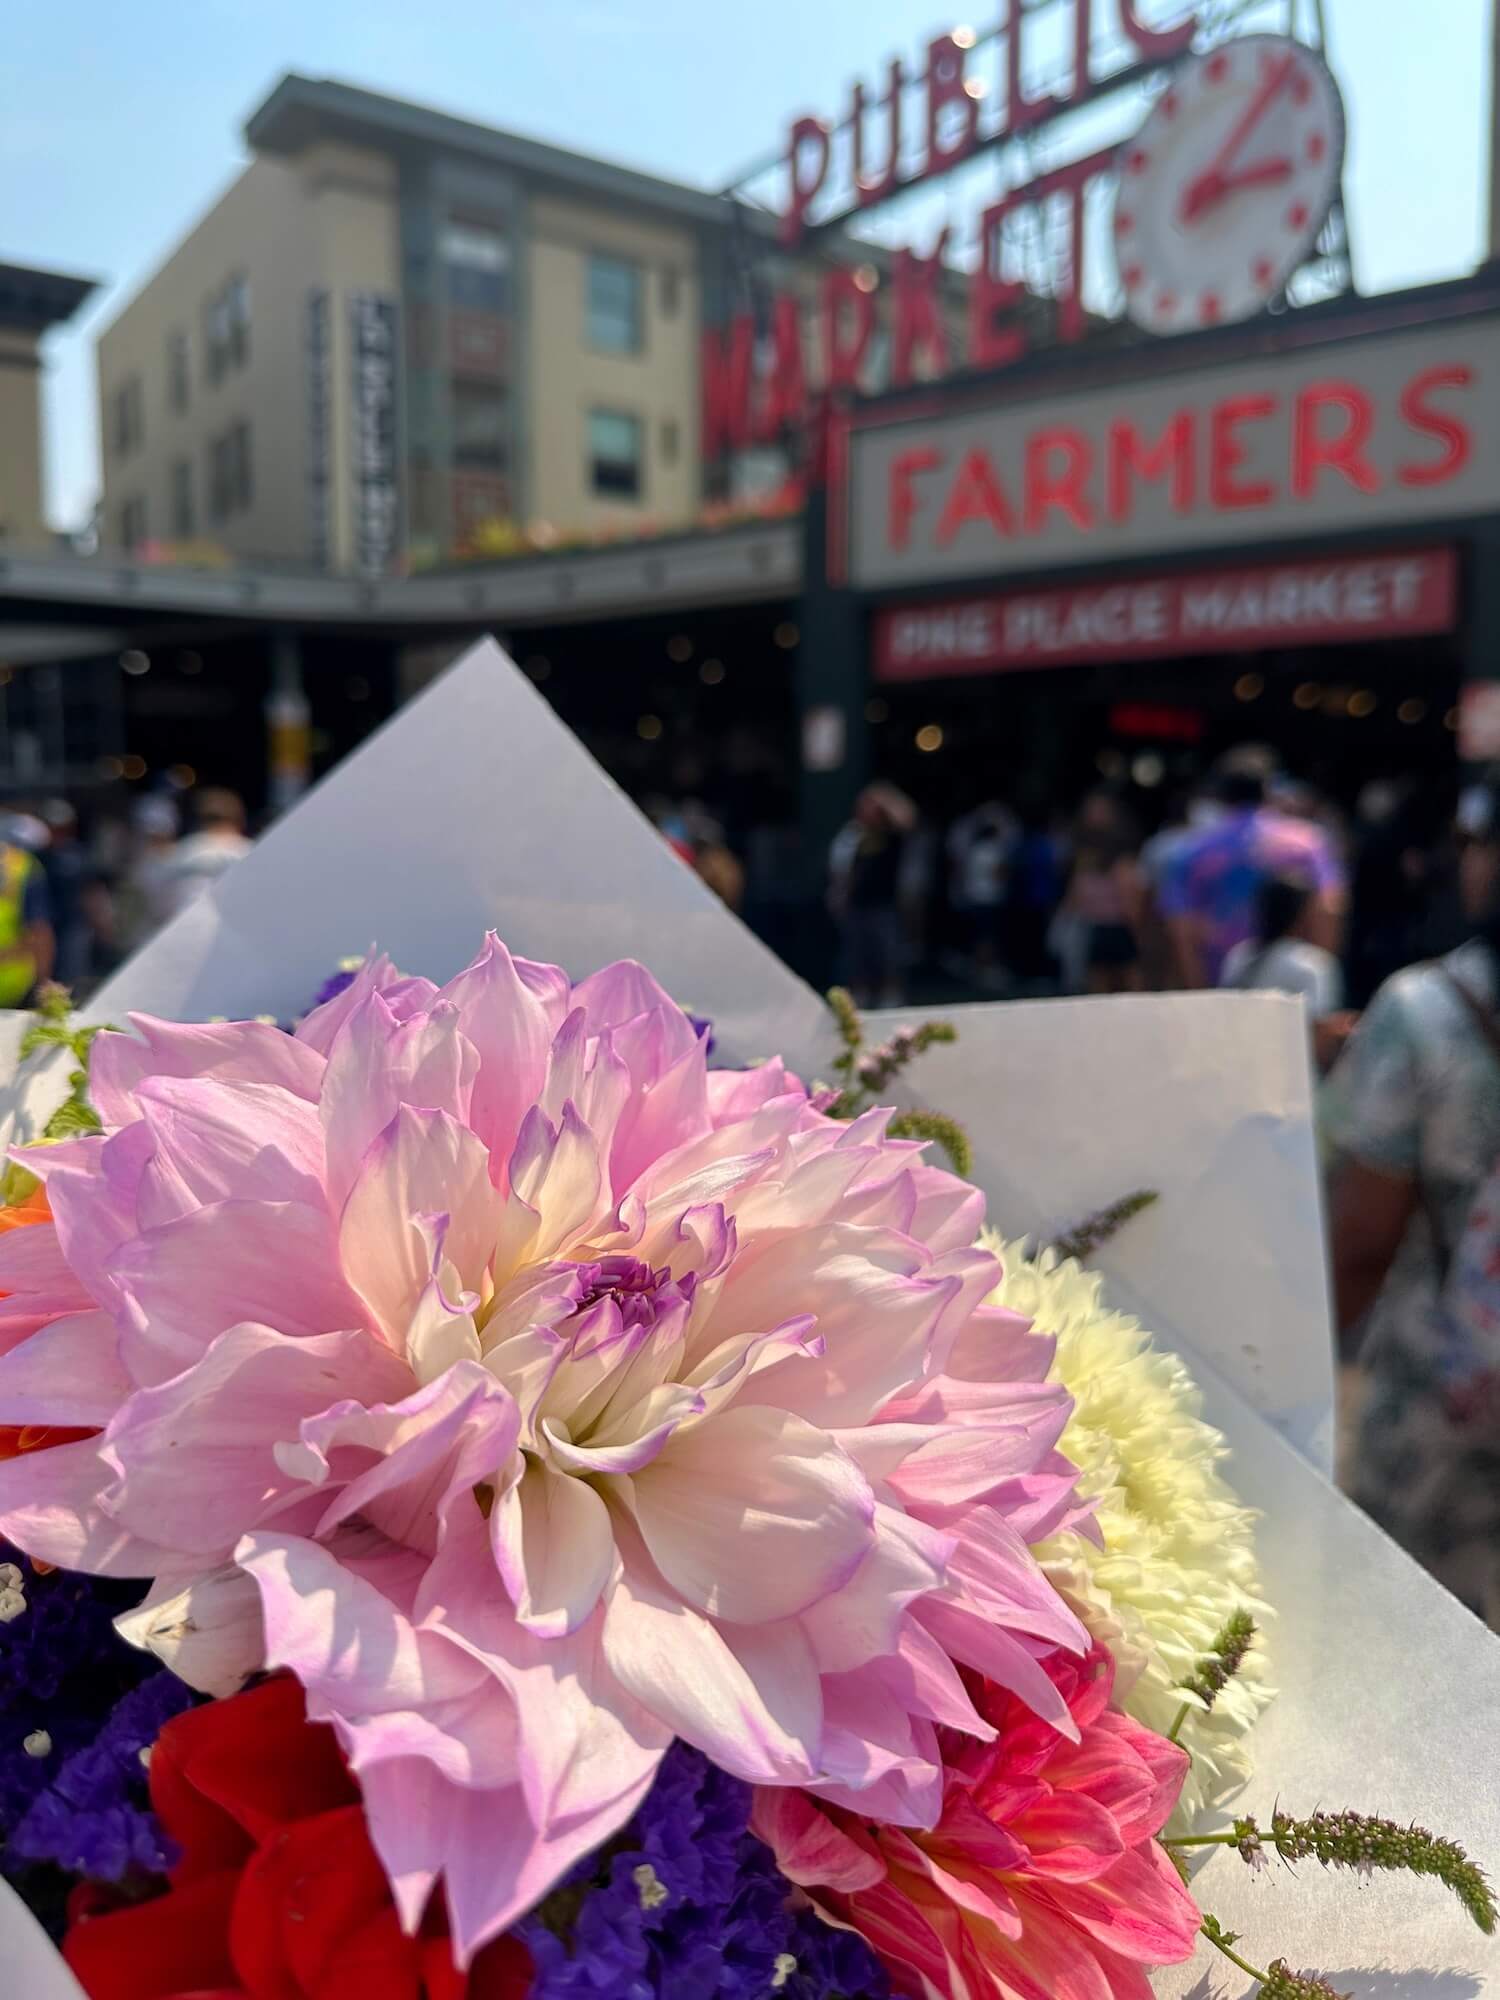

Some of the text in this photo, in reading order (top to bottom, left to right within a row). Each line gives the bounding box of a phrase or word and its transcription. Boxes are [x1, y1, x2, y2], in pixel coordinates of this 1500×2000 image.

[702, 148, 1114, 464] MARKET
[887, 365, 1477, 553] FARMERS
[891, 558, 1426, 660] PIKE PLACE MARKET
